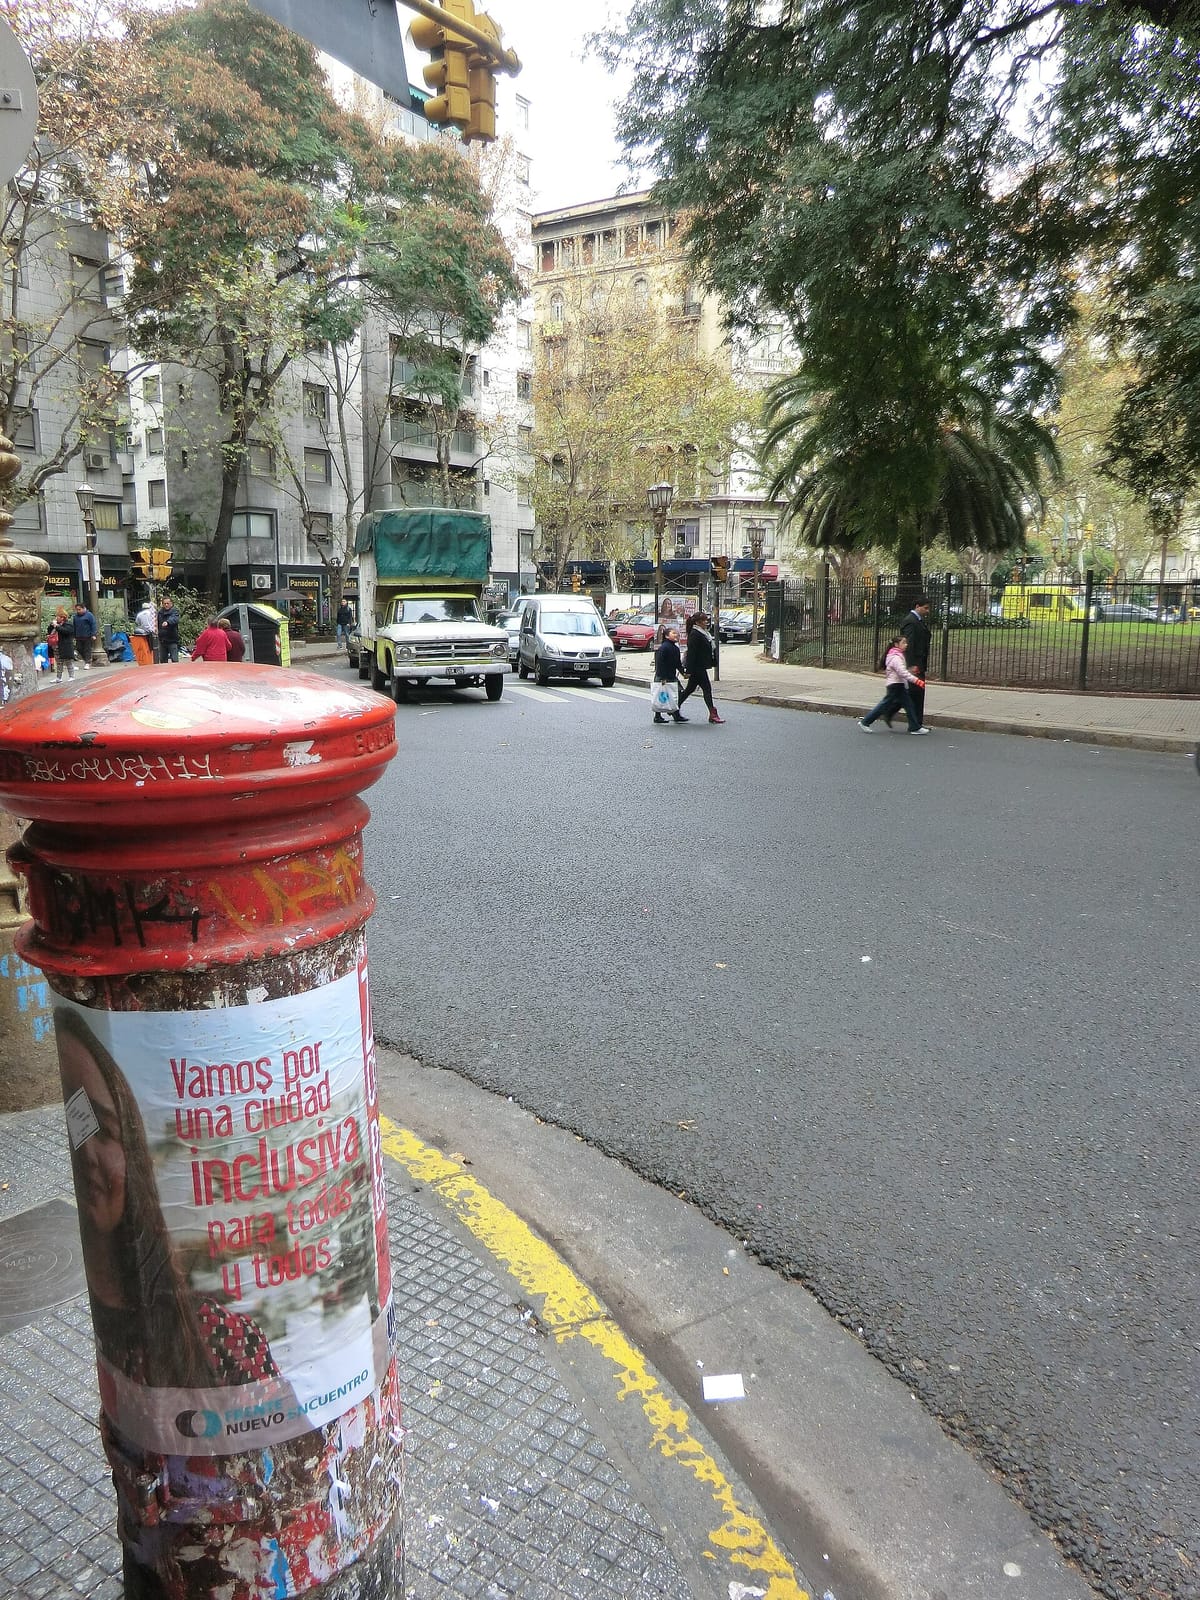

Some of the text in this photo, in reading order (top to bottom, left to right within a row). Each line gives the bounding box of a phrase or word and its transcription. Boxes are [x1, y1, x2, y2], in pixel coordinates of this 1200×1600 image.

[169, 1041, 323, 1099] Vamos por
[175, 1069, 331, 1140] una ciudad
[191, 1115, 360, 1207] inclusiva
[207, 1177, 352, 1260] para todas
[222, 1236, 332, 1301] y todos
[224, 1398, 283, 1422] FRENTE
[226, 1369, 369, 1436] NUEVO ENCUENTRO
